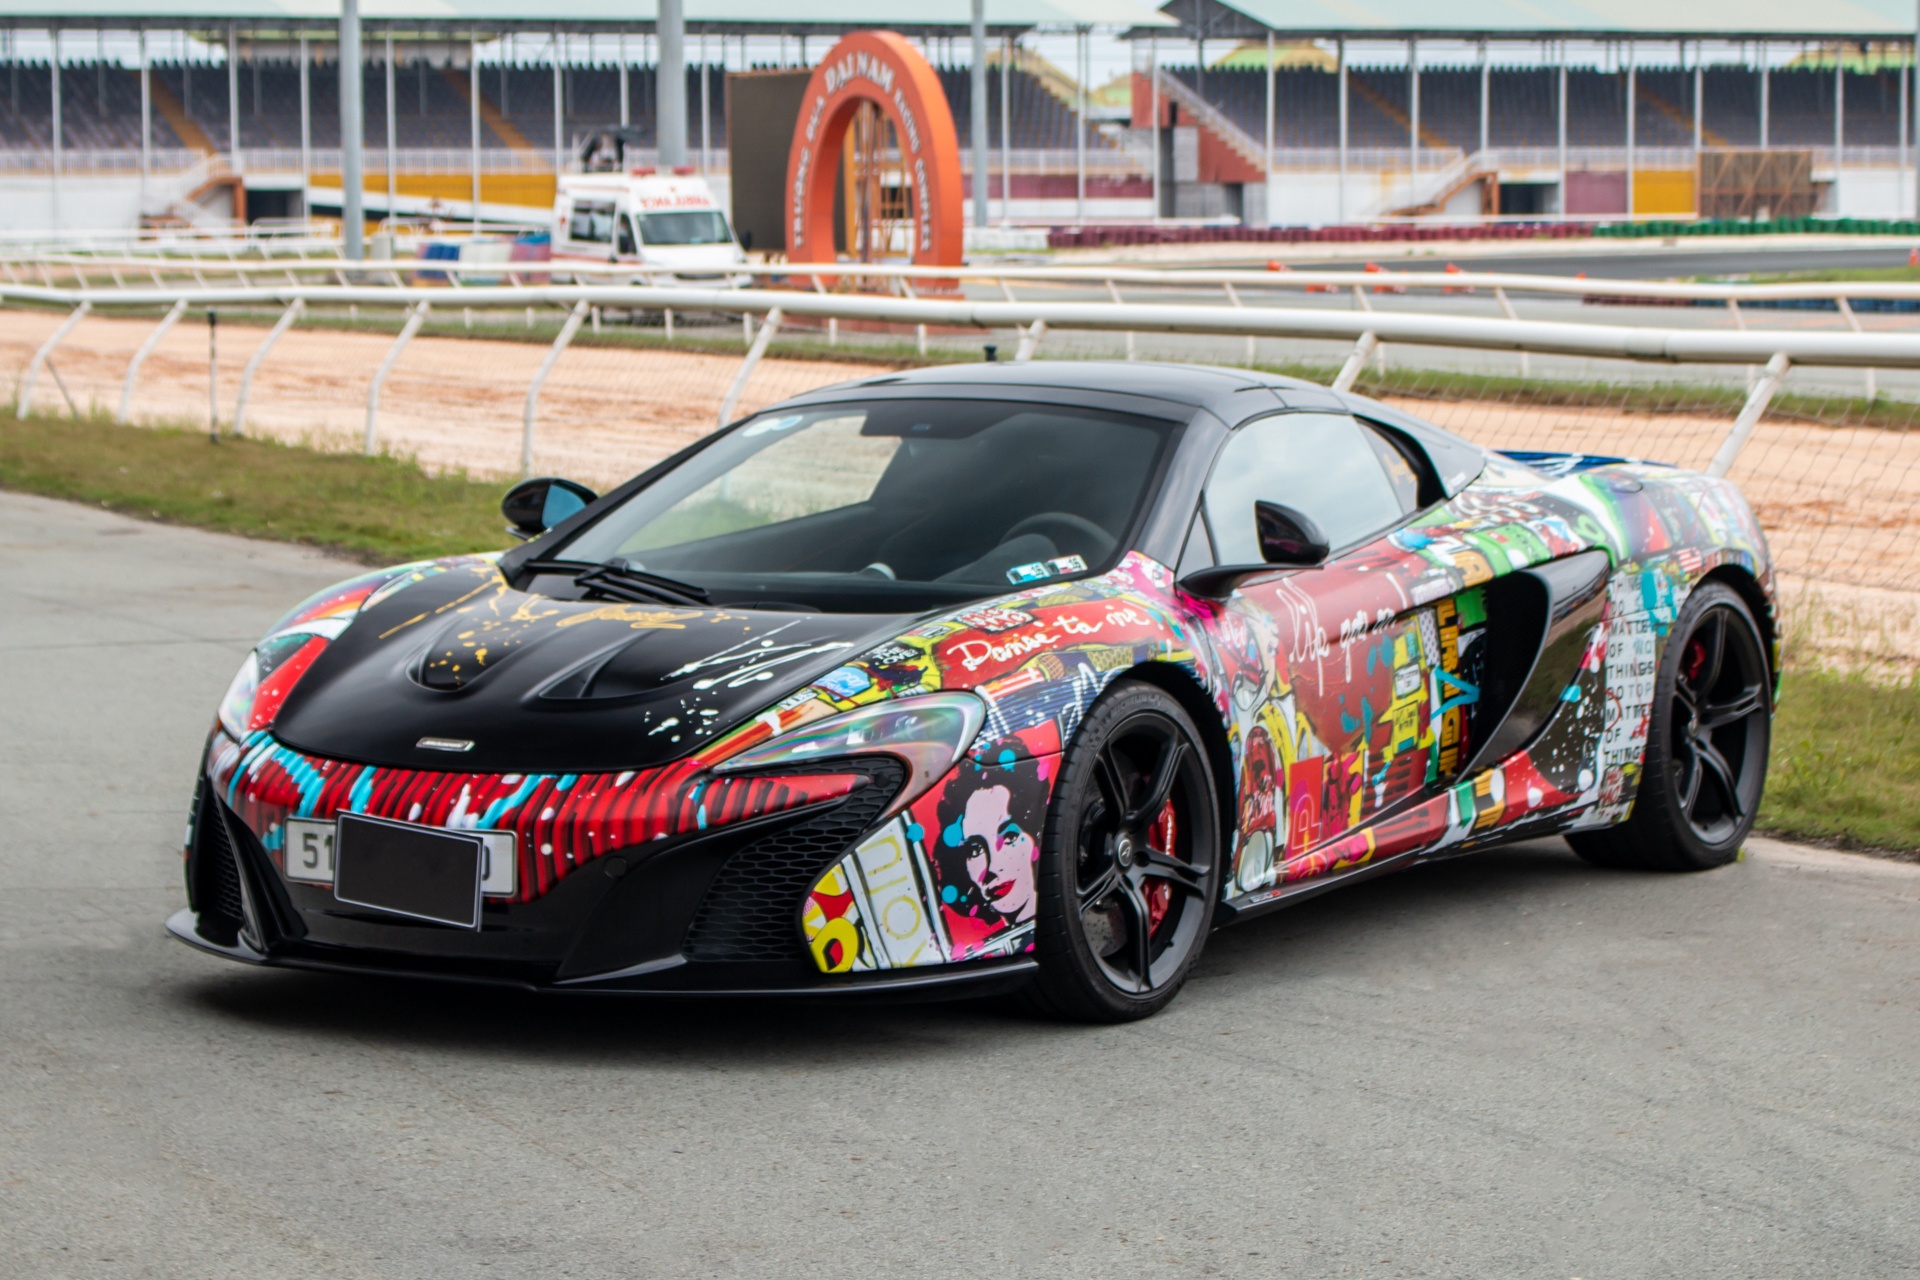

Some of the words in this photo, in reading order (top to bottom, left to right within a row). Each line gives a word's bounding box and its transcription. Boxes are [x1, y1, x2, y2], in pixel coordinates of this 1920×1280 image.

[857, 51, 895, 94] NAM
[1608, 641, 1624, 659] OF
[1605, 729, 1621, 744] OF
[302, 831, 334, 871] 51
